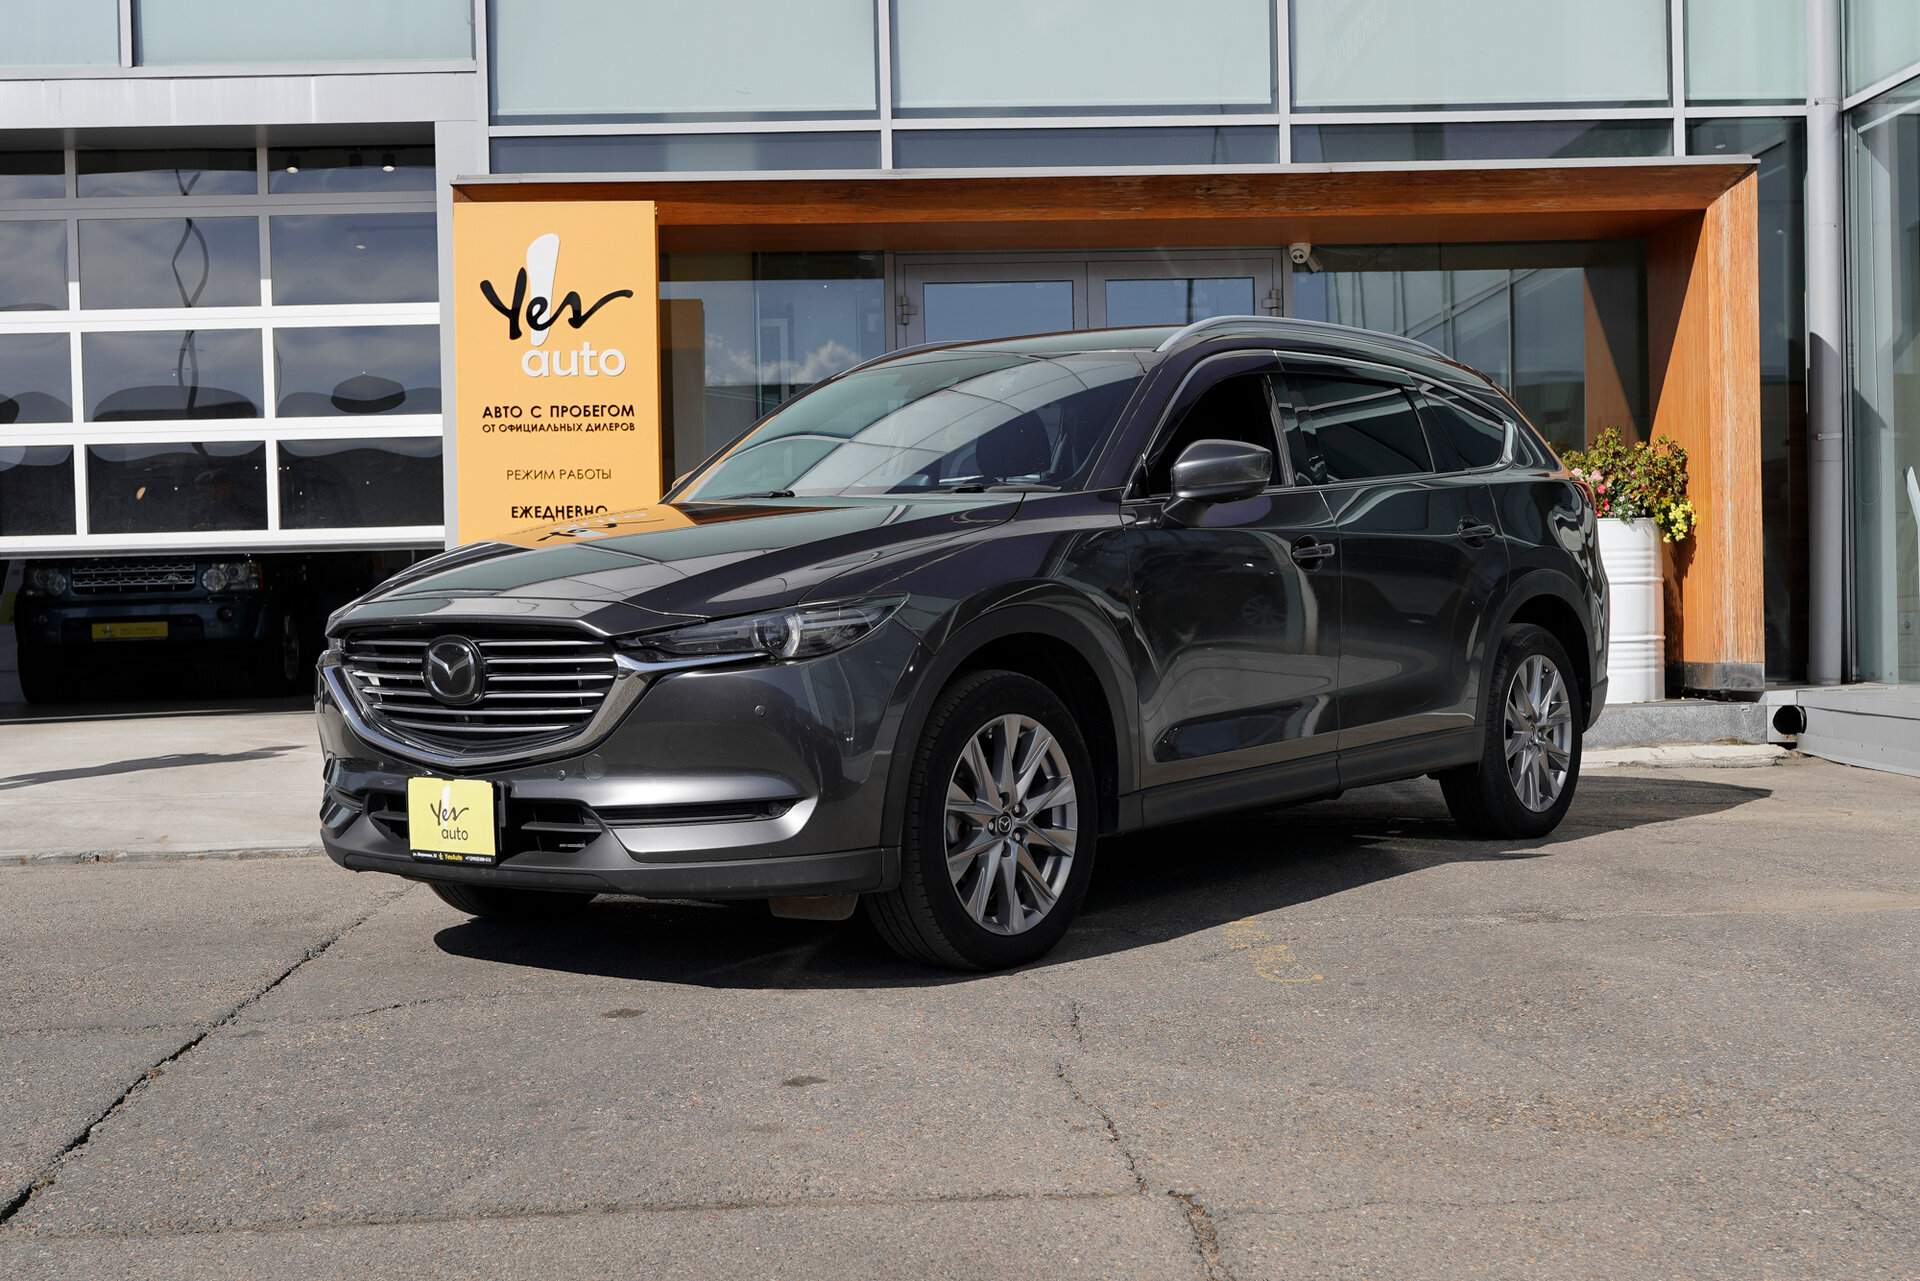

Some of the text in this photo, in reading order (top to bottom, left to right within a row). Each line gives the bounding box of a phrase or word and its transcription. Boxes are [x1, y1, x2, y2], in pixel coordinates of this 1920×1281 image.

[480, 267, 633, 340] Yes
[522, 342, 626, 377] auto
[482, 404, 634, 418] АВТО С ПРОБЕГОМ
[482, 422, 635, 433] ОТ ОФИЦИАЛЬНЫХ ДИЛЕРОВ
[506, 468, 612, 480] РЕЖИМ РАБОТЫ
[430, 800, 469, 826] Yes
[441, 827, 469, 841] auto
